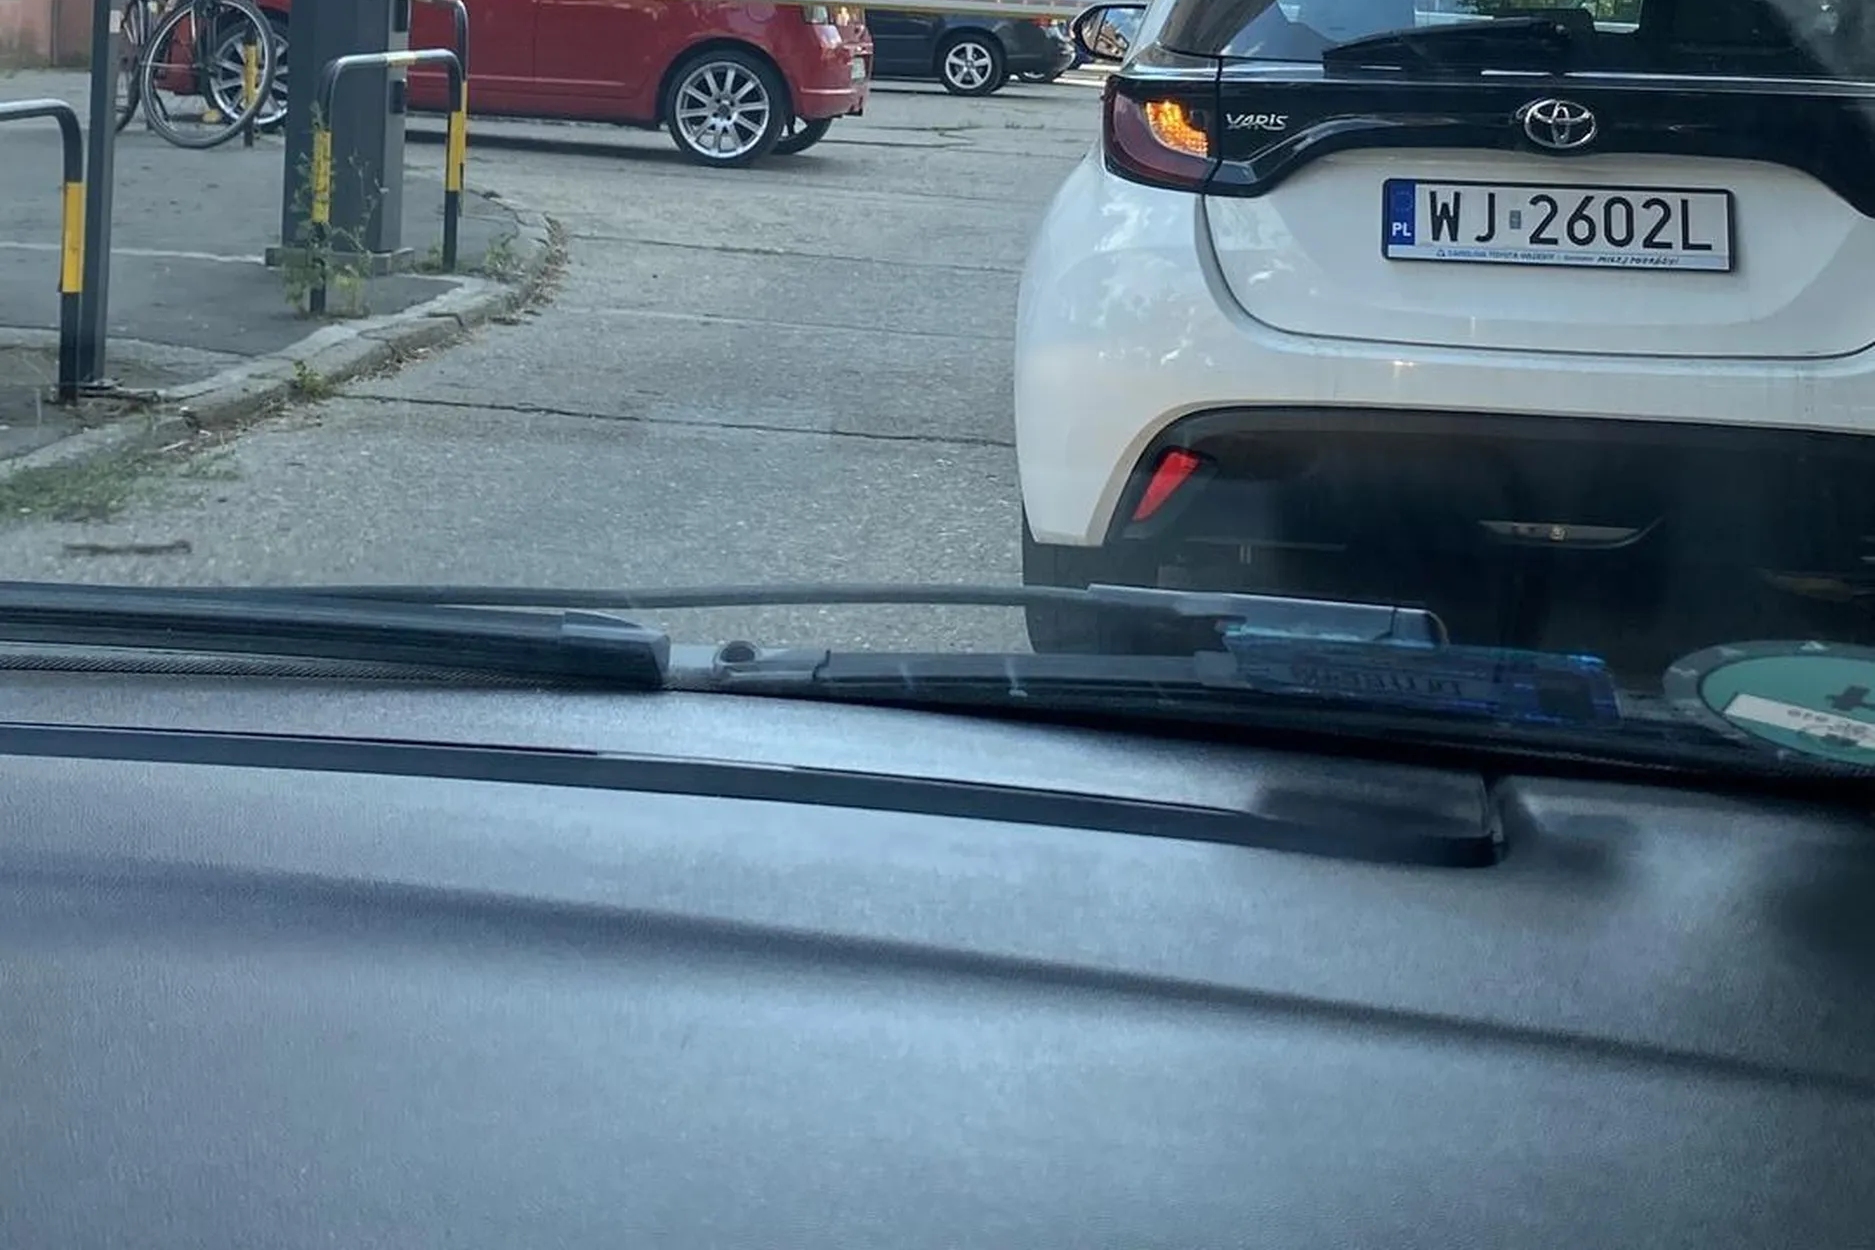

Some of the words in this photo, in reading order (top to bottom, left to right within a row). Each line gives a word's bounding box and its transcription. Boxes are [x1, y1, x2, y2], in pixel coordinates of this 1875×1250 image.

[1225, 113, 1289, 130] YARIS
[1429, 190, 1496, 243] WJ
[1529, 194, 1713, 251] 2602L
[1392, 222, 1412, 237] PL
